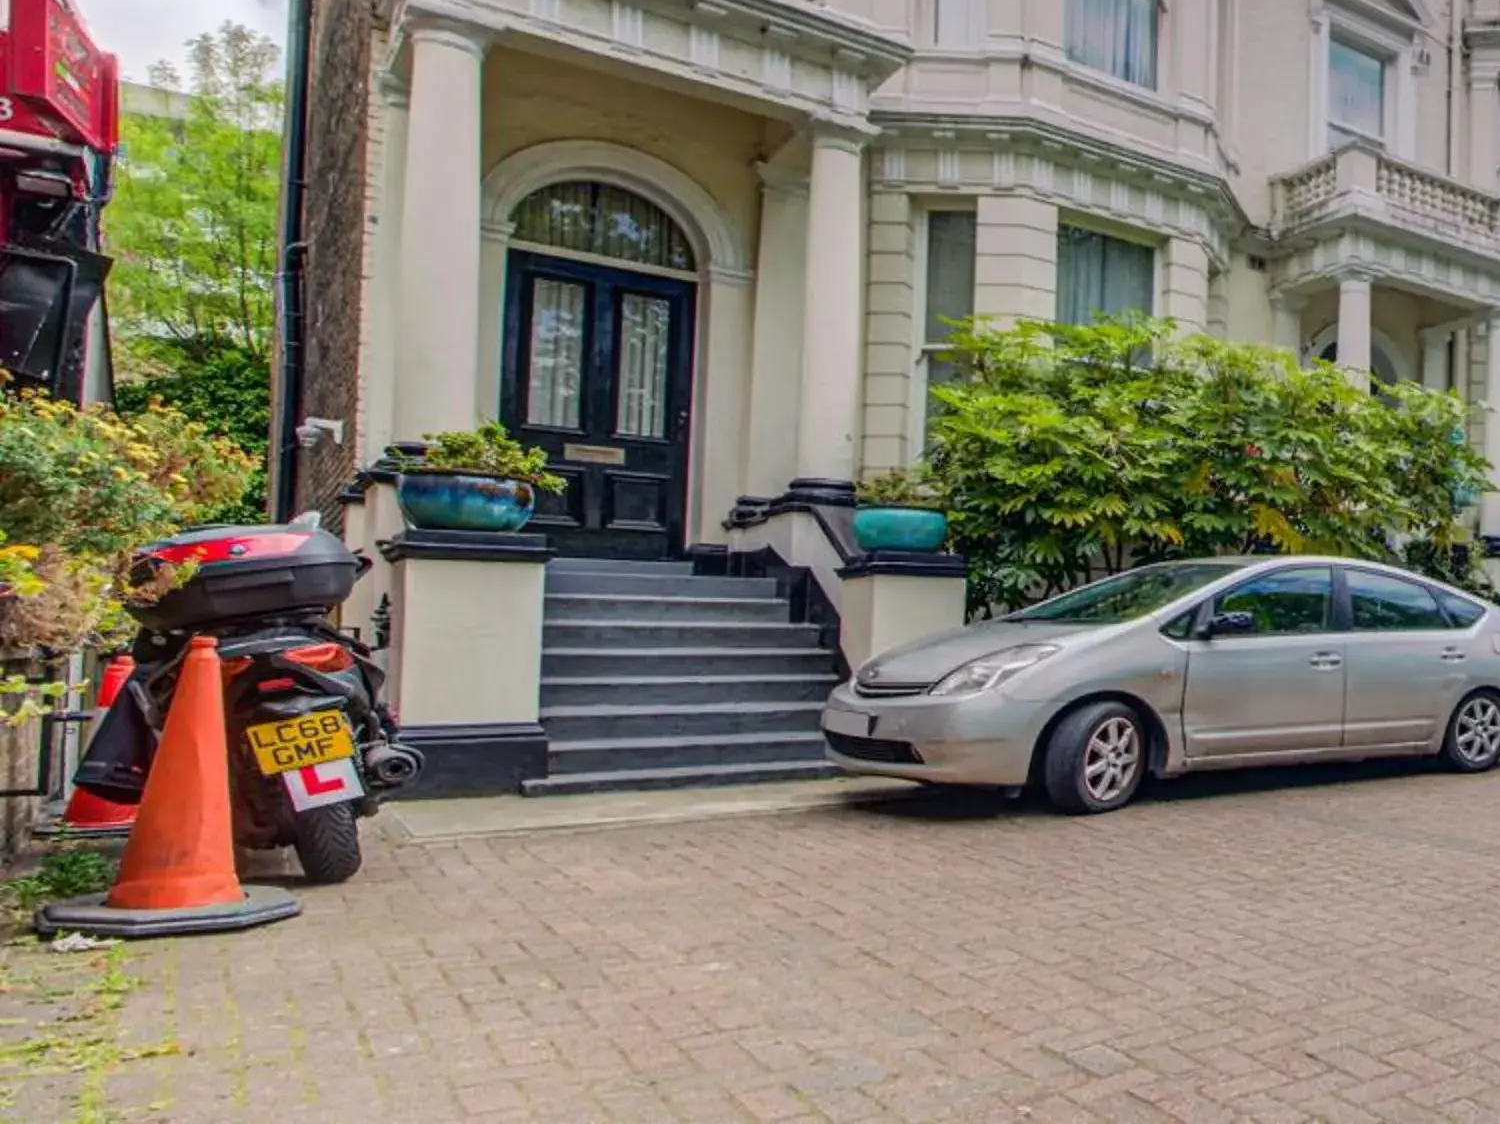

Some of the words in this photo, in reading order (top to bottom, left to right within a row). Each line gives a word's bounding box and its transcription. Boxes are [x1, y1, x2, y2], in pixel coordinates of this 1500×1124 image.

[252, 715, 342, 749] LC68
[272, 736, 334, 766] GMF
[299, 764, 346, 797] L
